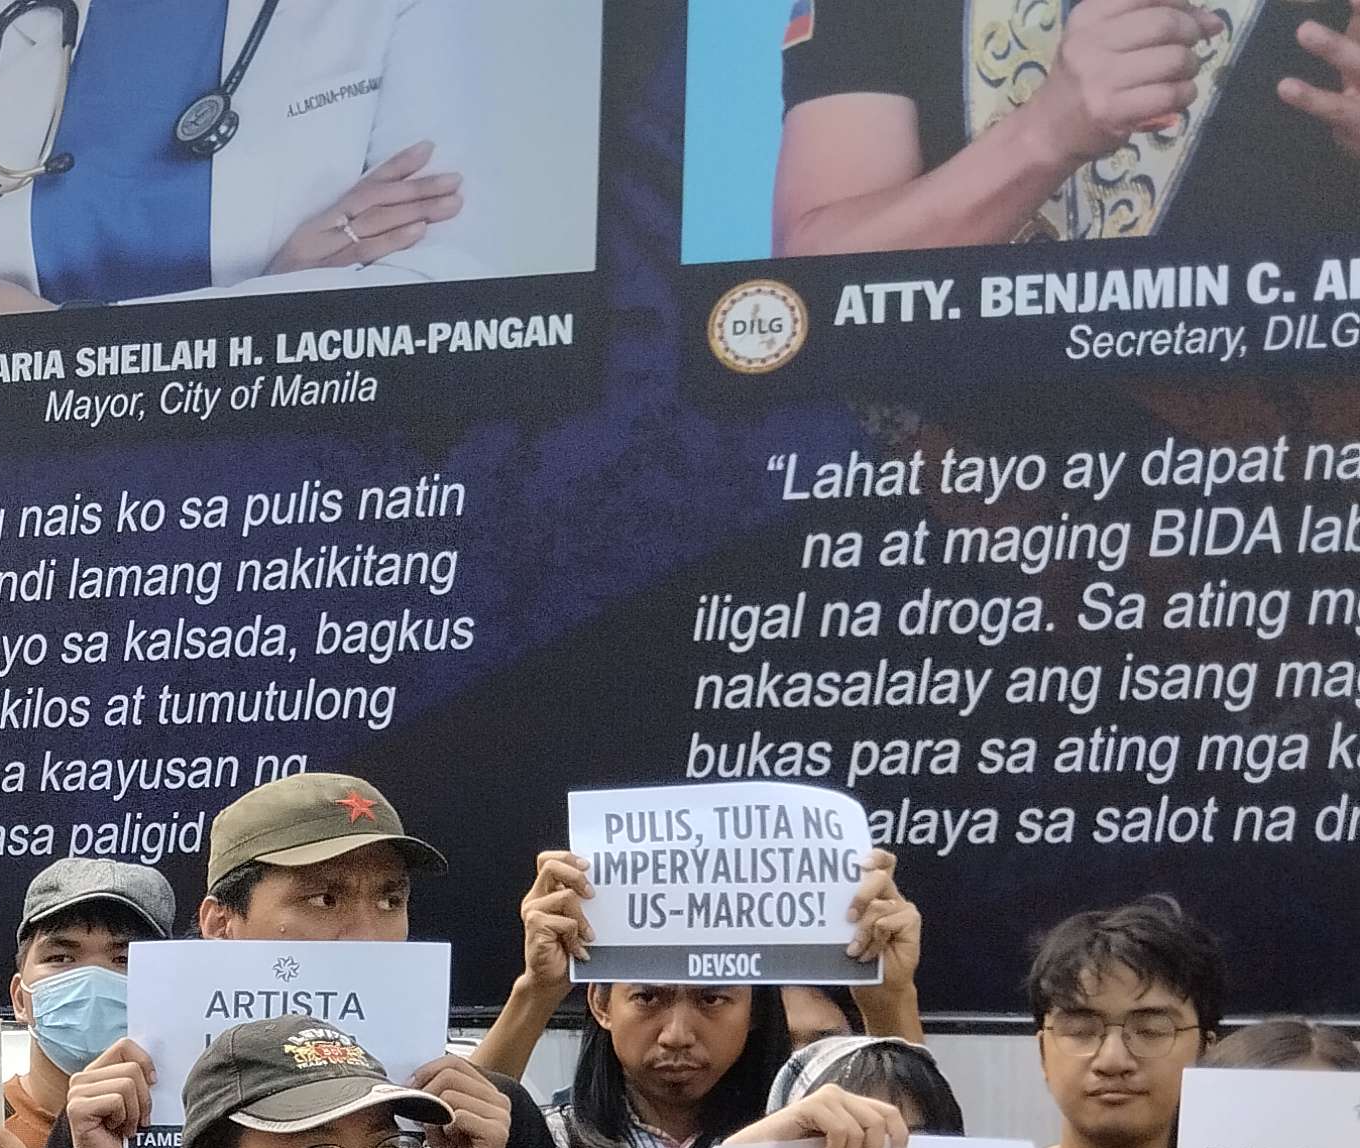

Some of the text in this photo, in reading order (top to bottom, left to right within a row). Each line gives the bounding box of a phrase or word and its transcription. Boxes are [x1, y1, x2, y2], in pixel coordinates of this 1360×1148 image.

[834, 281, 962, 326] ATTY.
[980, 265, 1229, 318] BENJAMIN
[1247, 262, 1296, 304] C.
[75, 339, 216, 377] SHEILAH
[229, 335, 263, 367] H.
[275, 314, 574, 364] LACUNA-PANGAN
[732, 317, 783, 336] DILG
[1066, 312, 1360, 364] Secretary, DILG
[45, 370, 378, 427] Mayor, City of Manila
[940, 448, 1046, 505] tayo
[1063, 452, 1126, 502] ay
[1140, 436, 1286, 496] dapat
[1303, 444, 1360, 482] na
[18, 501, 104, 537] nais
[116, 491, 166, 533] ko
[179, 498, 229, 528] sa
[241, 482, 343, 537] pulis
[357, 475, 465, 520] natin
[802, 505, 1283, 574] na at maging BIDA
[67, 553, 222, 605] lamang
[235, 545, 459, 600] nakikitang
[694, 654, 1256, 716] nakasalalay ang isang
[605, 805, 844, 847] PULIS, TUTA NG
[593, 848, 861, 885] IMPERYALISTANG
[629, 892, 826, 929] US-MARCOS!
[688, 953, 762, 977] DEVSOC
[205, 990, 365, 1021] ARTISTA
